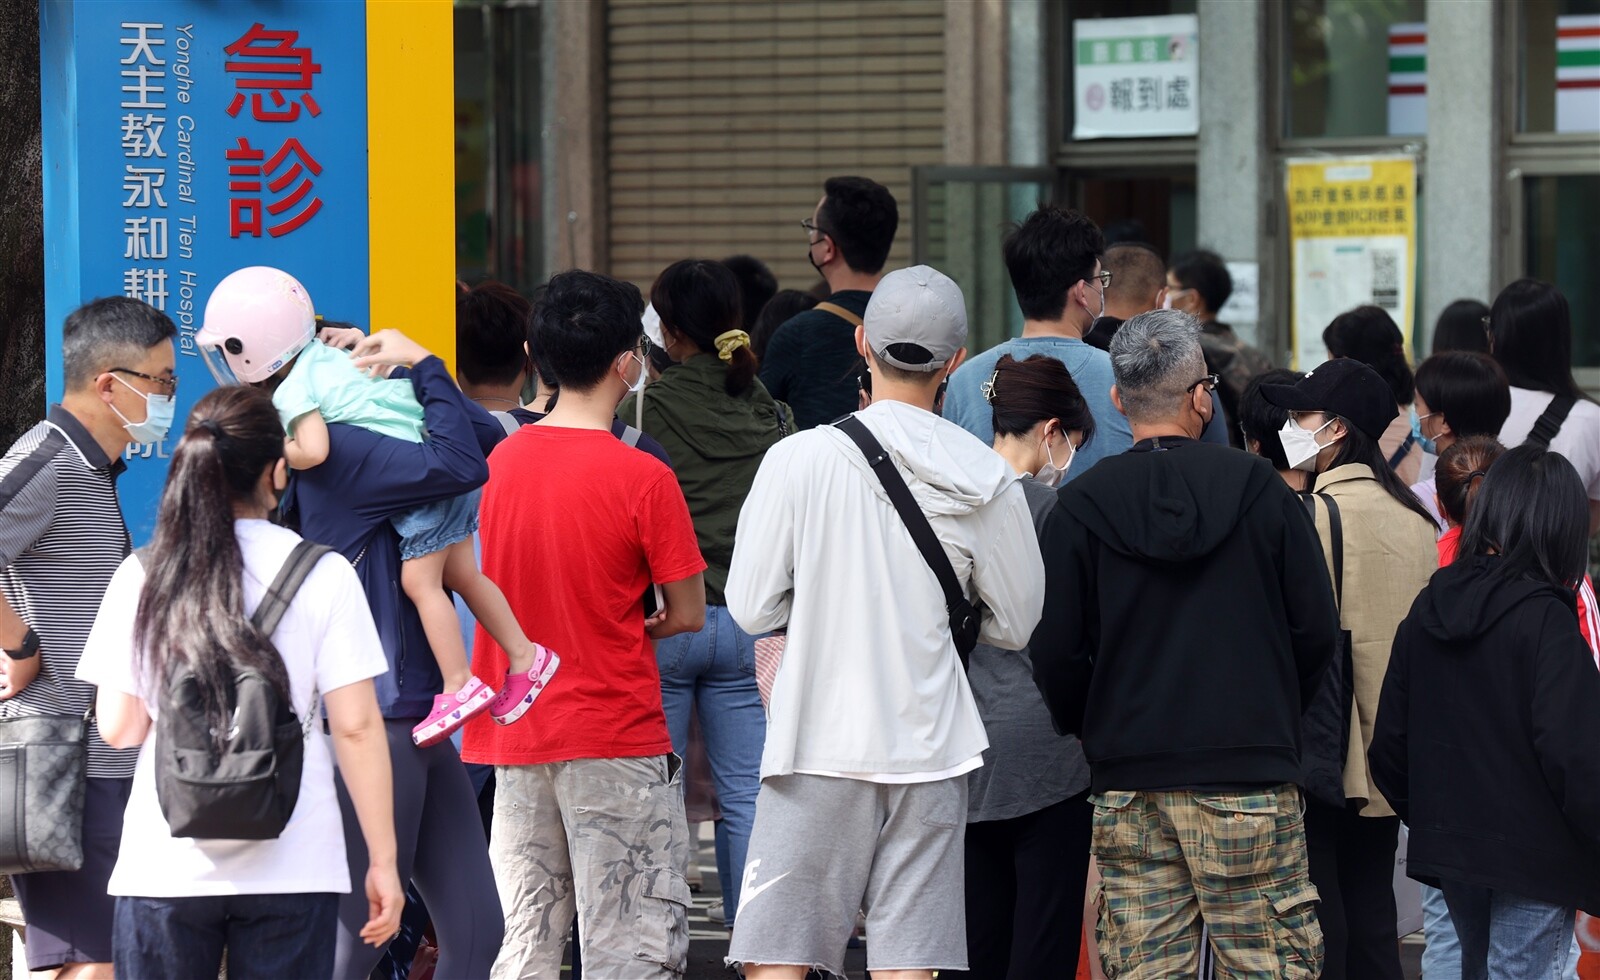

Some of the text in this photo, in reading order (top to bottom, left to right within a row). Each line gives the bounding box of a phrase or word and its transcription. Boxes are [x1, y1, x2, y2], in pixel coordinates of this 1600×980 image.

[173, 23, 198, 357] Yonghe Cardinal Tien Hospital
[224, 22, 323, 239] 急診
[1109, 75, 1191, 112] 報到處
[120, 21, 170, 460] 天主教永和耕
